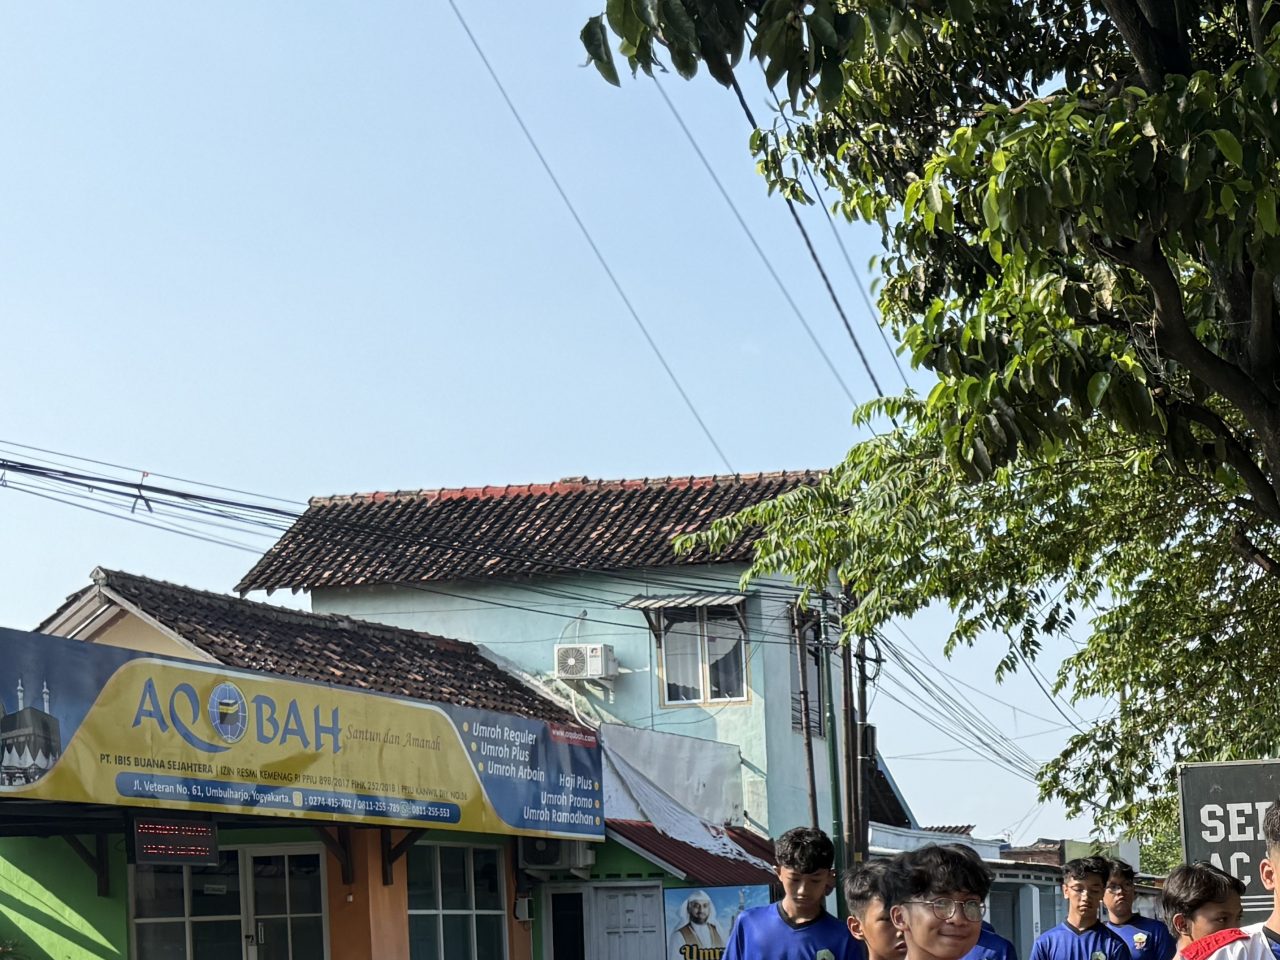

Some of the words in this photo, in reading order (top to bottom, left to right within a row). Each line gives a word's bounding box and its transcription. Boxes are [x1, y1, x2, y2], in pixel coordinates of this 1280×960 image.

[345, 724, 381, 743] Santun
[383, 728, 400, 744] dan
[402, 732, 440, 751] Amanah
[473, 722, 502, 741] Umroh
[504, 727, 537, 746] Reguler
[480, 742, 509, 758] Umroh
[511, 746, 530, 762] Plus
[100, 753, 112, 765] PT.
[114, 755, 131, 767] IBIS
[135, 757, 165, 769] BUANA
[167, 760, 213, 774] SEJAHTERA
[220, 765, 235, 776] IZIN
[237, 768, 257, 778] RESMI
[260, 770, 293, 781] KEMENAG
[487, 761, 516, 778] Umroh
[518, 767, 545, 782] Arbain
[134, 779, 142, 791] Jl.
[143, 781, 174, 793] Veteran
[176, 783, 190, 795] No.
[192, 785, 204, 797] 61,
[205, 786, 251, 802] Umbulharjo,
[559, 773, 575, 790] Haji
[577, 775, 593, 790] Plus
[541, 791, 567, 806] Umroh
[569, 794, 593, 809] Promo
[523, 806, 550, 820] Umroh
[552, 809, 594, 826] Ramadhan
